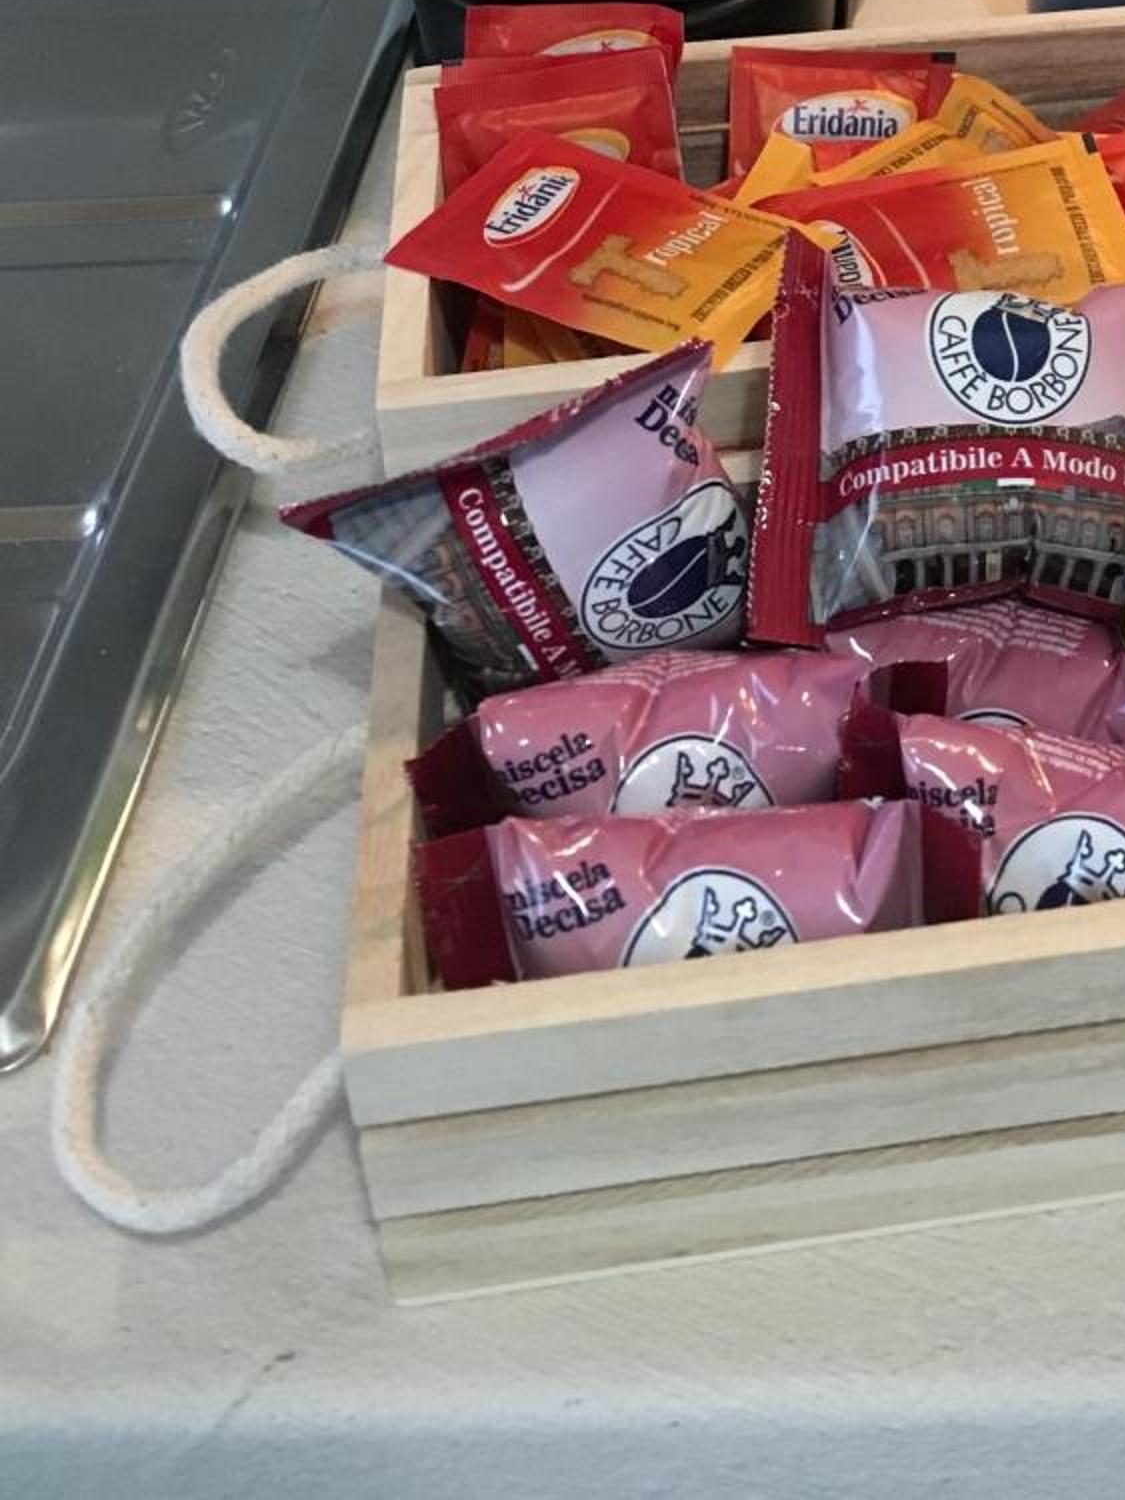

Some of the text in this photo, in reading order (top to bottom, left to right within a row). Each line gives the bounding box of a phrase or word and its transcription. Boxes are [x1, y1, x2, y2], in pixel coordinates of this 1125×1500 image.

[793, 105, 898, 139] Eridania
[840, 446, 1003, 497] Compatibile
[1011, 447, 1034, 469] A
[1043, 448, 1117, 482] Modo
[458, 487, 568, 663] Compatibile A
[591, 590, 729, 644] BORBONE
[520, 757, 607, 806] ecisa
